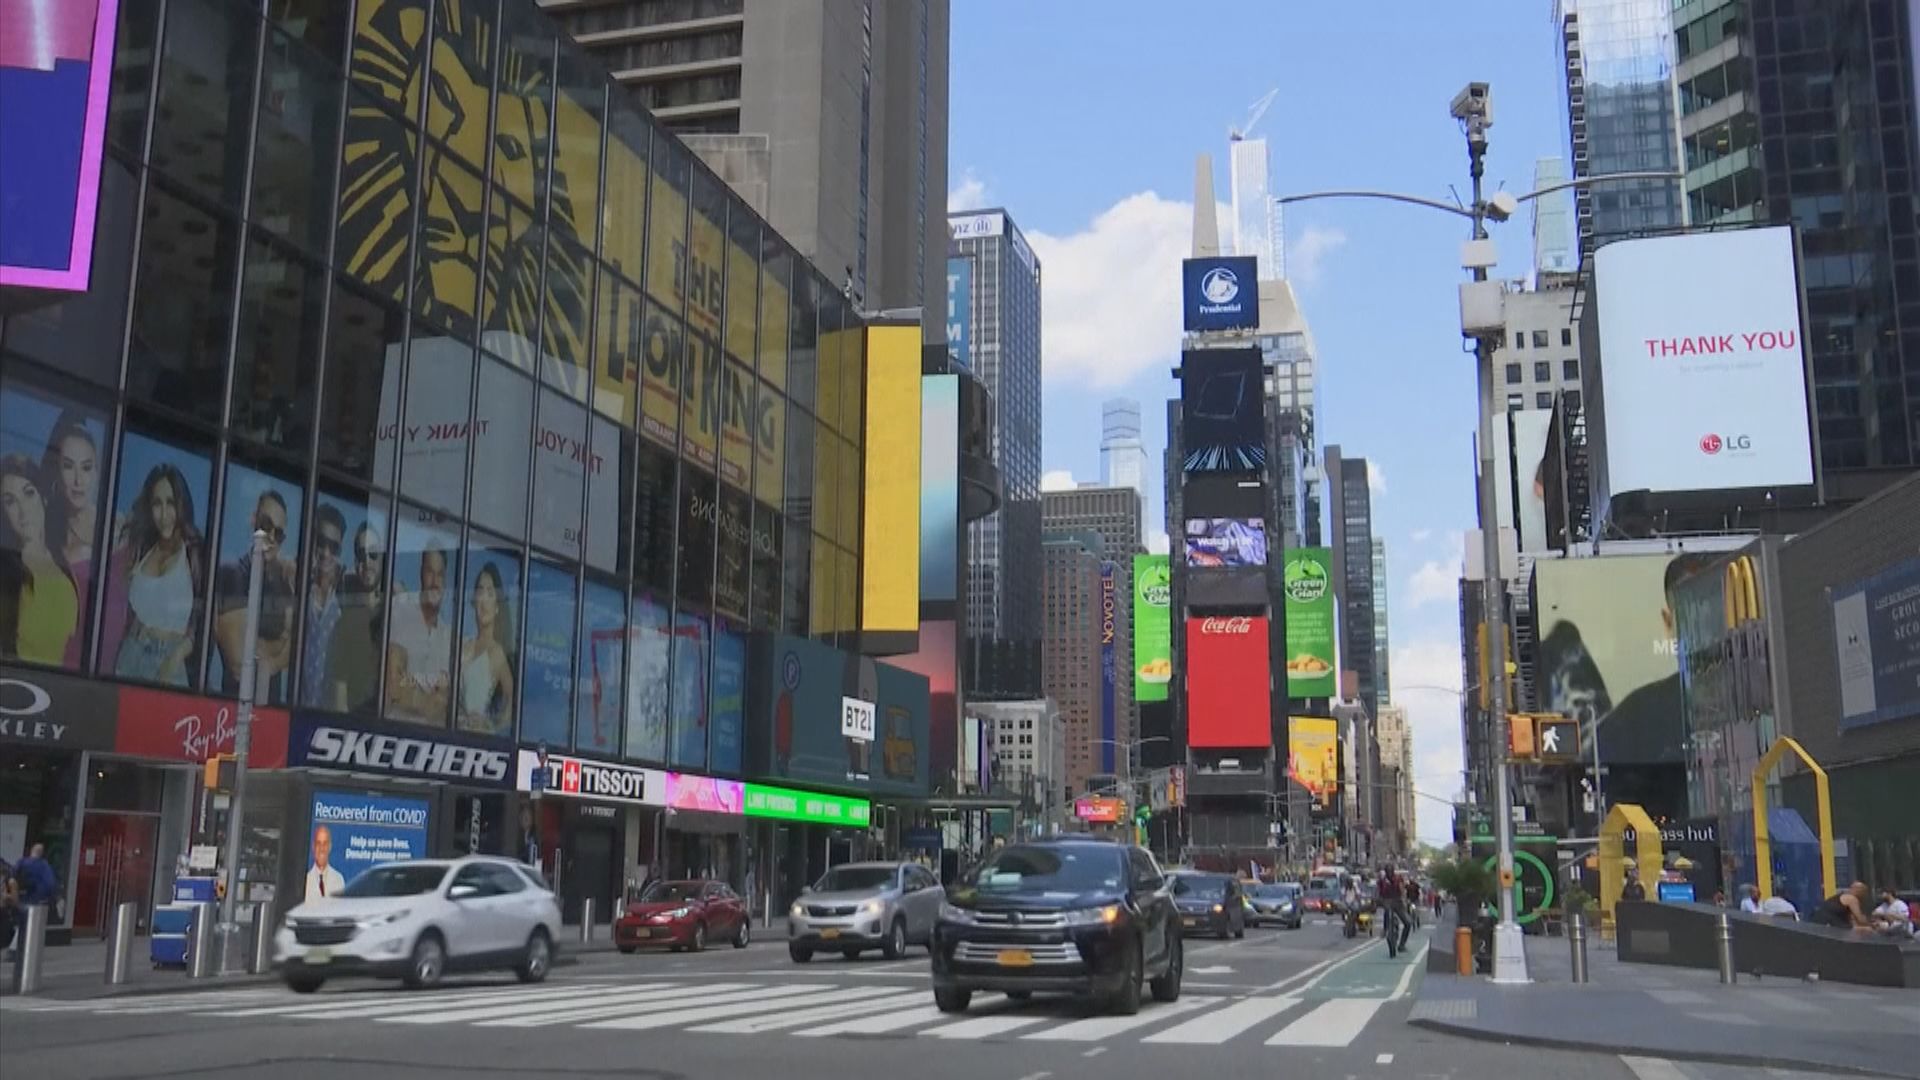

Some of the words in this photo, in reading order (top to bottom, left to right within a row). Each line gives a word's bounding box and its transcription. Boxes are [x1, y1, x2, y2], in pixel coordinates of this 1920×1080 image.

[673, 237, 722, 315] THE
[1199, 303, 1241, 314] Prudential
[607, 259, 696, 401] LION
[700, 328, 776, 453] KING
[1645, 333, 1734, 358] THANK
[1741, 330, 1796, 351] YOU
[1726, 435, 1751, 450] LG
[1102, 571, 1114, 643] NOVOTEL
[175, 707, 259, 758] Ray-Ba
[846, 706, 871, 731] BT21
[306, 727, 510, 781] SKECHERS
[582, 766, 644, 798] TISSOT
[315, 802, 367, 821] Recovered
[369, 805, 392, 822] from
[393, 808, 426, 825] COVID?
[470, 798, 482, 852] SKEC
[351, 836, 367, 849] Help
[368, 838, 377, 848] us
[1687, 826, 1714, 841] hut
[345, 848, 371, 859] Donate
